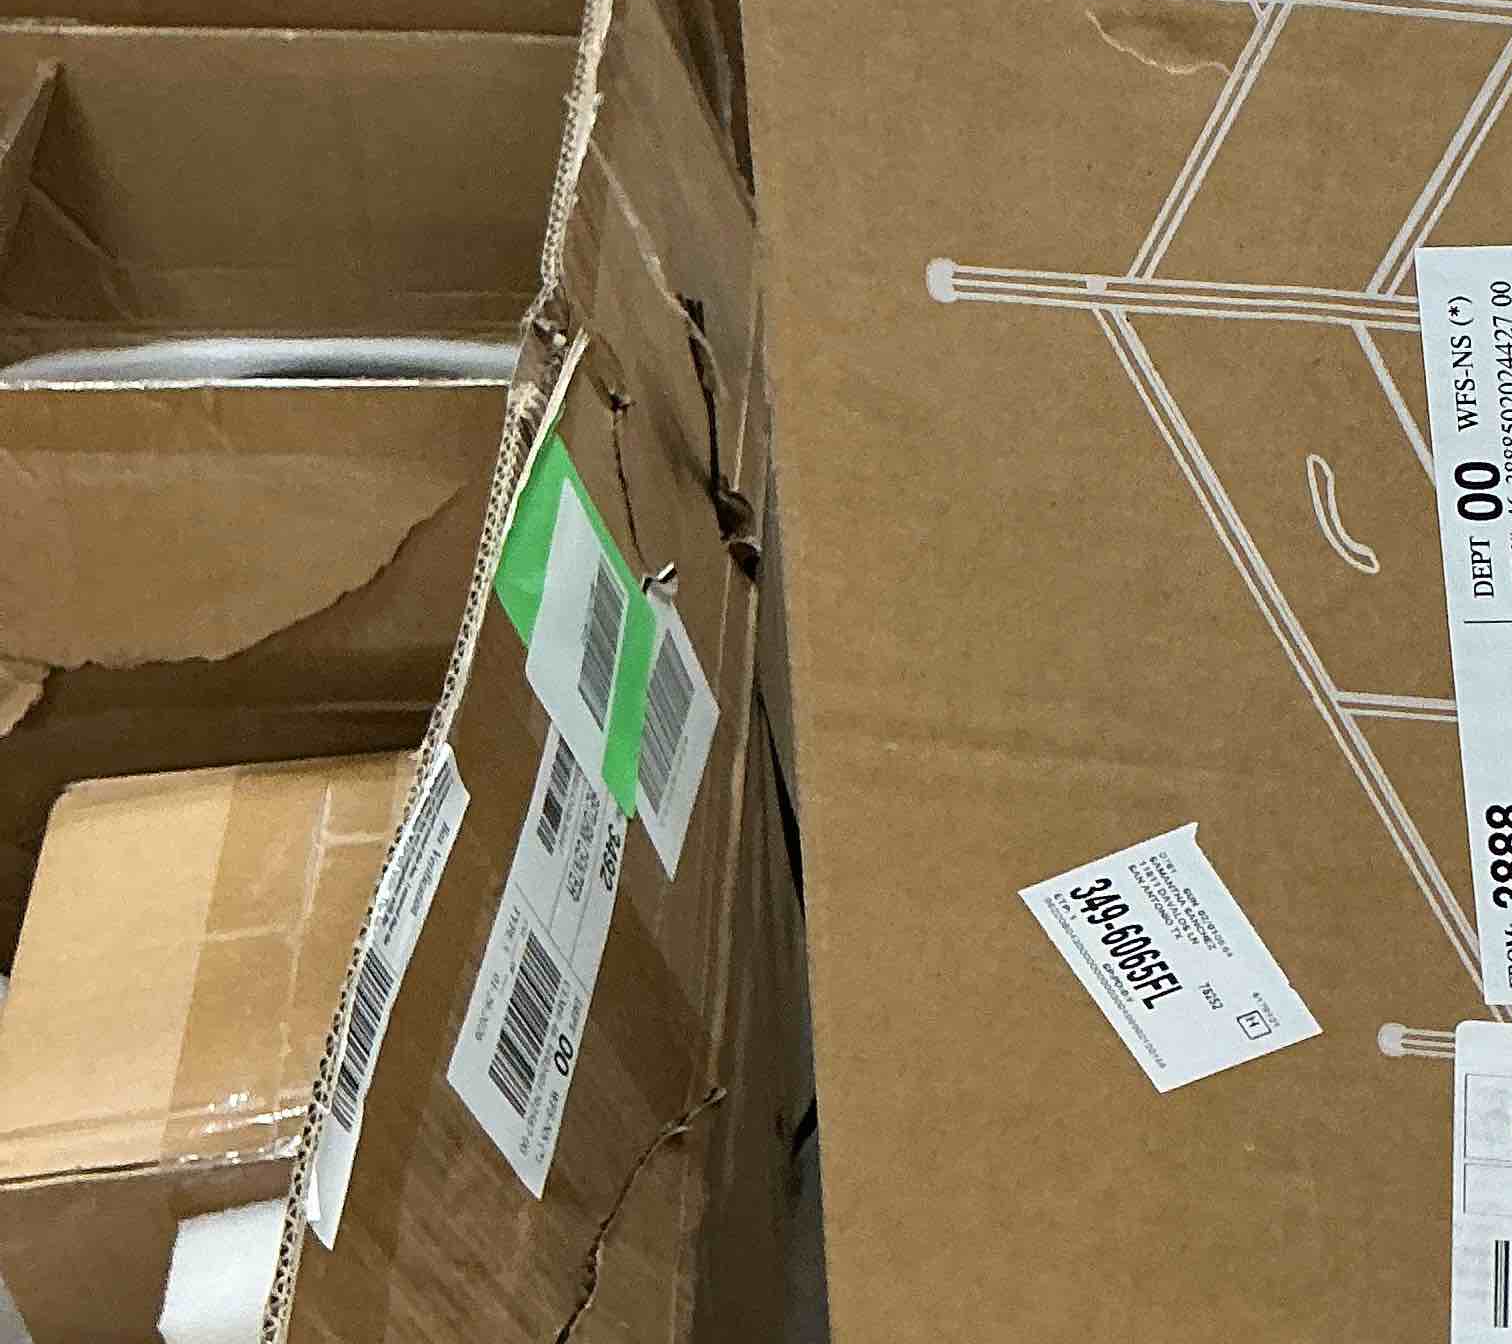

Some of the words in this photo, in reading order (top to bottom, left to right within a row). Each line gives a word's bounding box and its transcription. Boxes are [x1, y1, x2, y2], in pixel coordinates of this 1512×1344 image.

[1490, 281, 1512, 307] 00
[1450, 335, 1478, 432] WFS-NS
[1454, 462, 1503, 521] 00
[1469, 536, 1494, 598] DEPT
[600, 824, 620, 892] 3492
[1149, 856, 1186, 906] SAMANTHA
[1070, 878, 1183, 1010] 349-6065FL
[554, 1033, 573, 1077] 00
